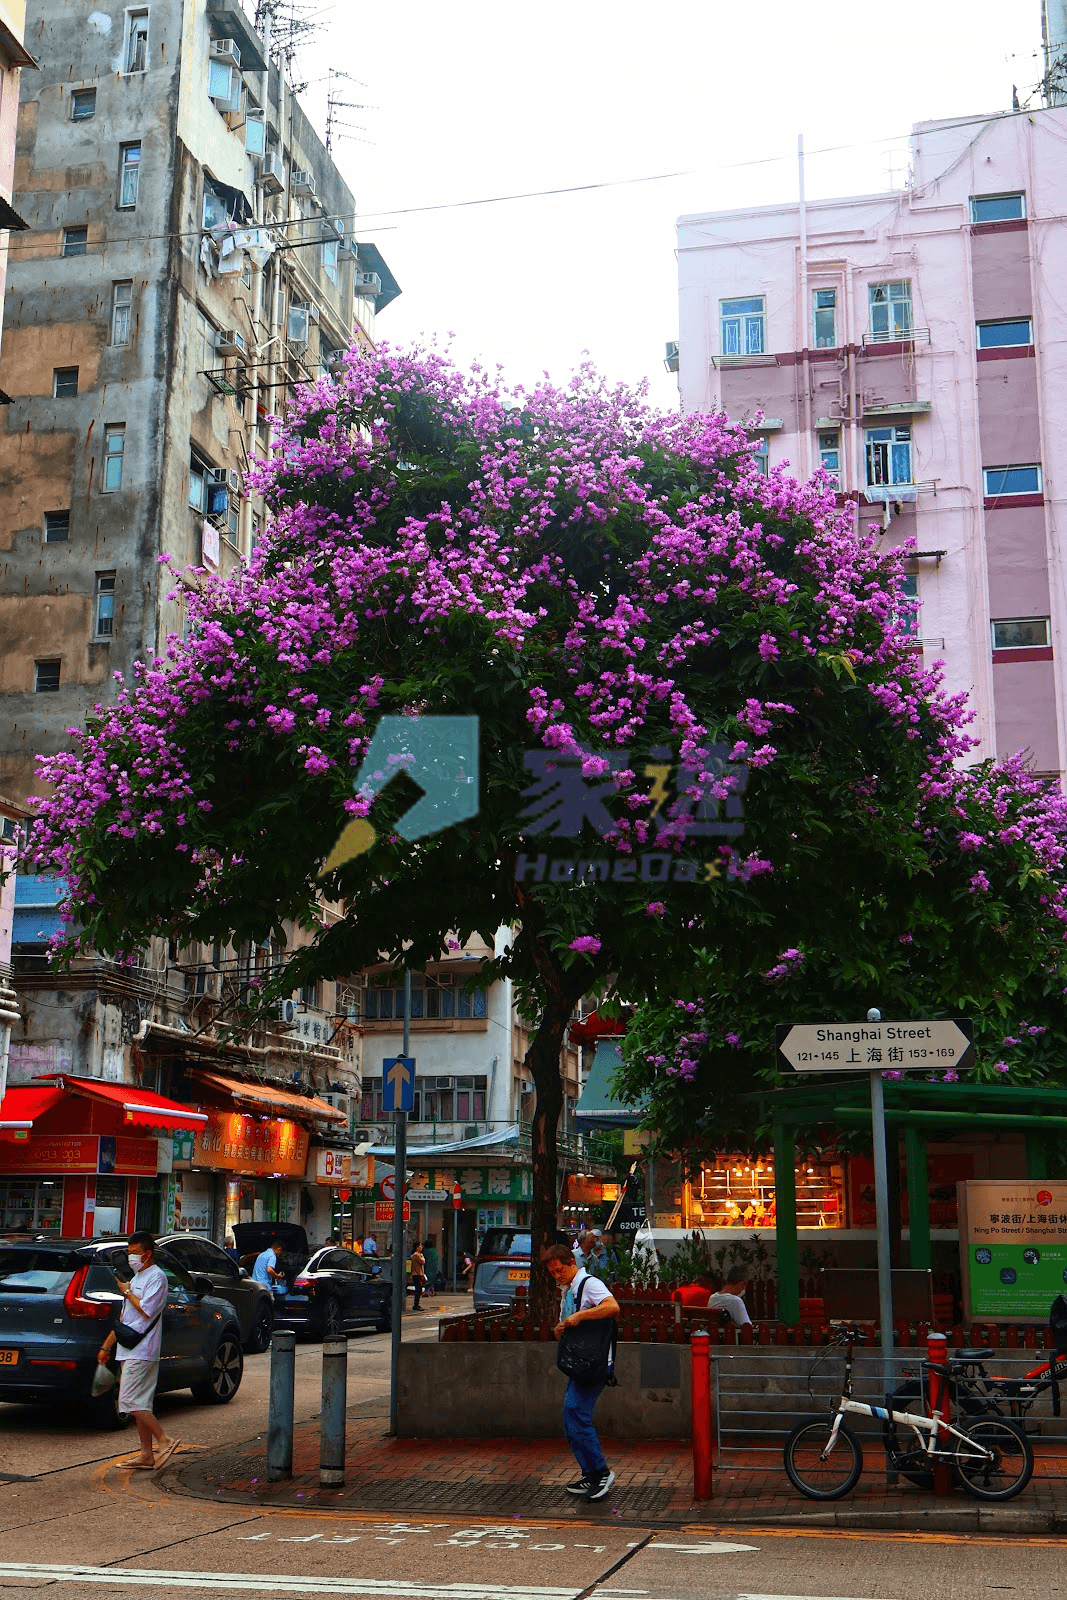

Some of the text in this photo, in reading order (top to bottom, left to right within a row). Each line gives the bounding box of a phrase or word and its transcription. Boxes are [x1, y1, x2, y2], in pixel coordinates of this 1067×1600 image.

[817, 1026, 932, 1042] Shanghai Street
[845, 1046, 904, 1063] 上海街
[974, 1227, 989, 1235] Ning
[1025, 1227, 1056, 1235] Shanghai
[236, 1532, 608, 1554] LOOK LEFT
